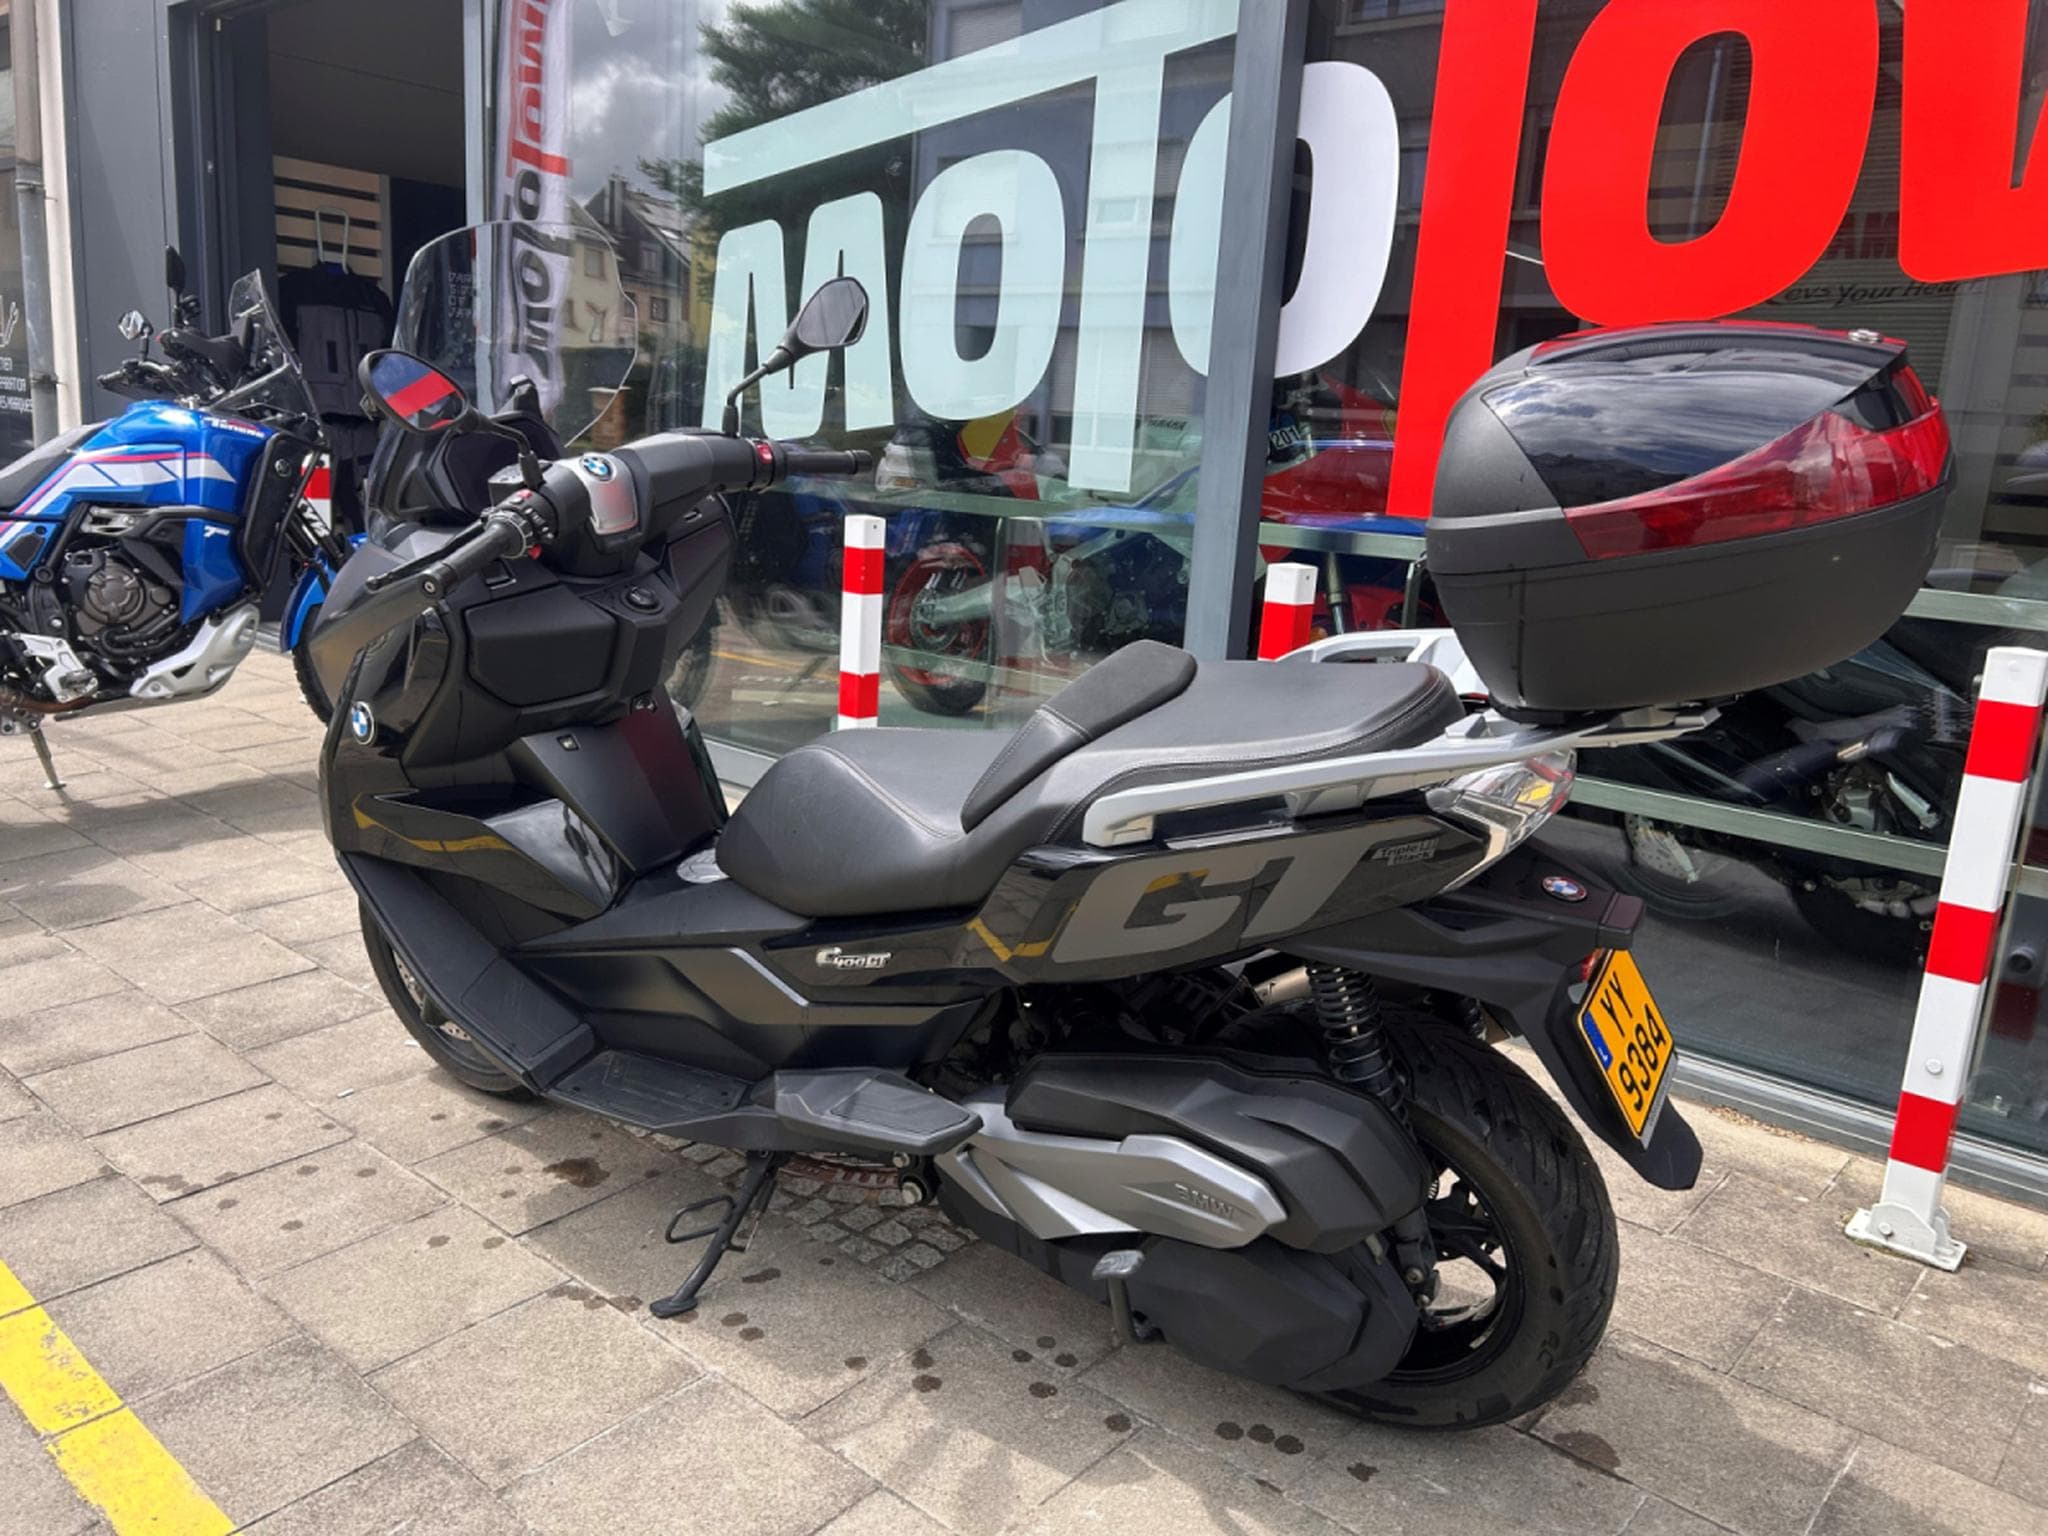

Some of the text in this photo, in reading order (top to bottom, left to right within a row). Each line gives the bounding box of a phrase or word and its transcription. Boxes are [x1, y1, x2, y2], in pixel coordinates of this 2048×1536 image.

[1600, 971, 1633, 1038] YY
[1618, 1003, 1666, 1112] 9384
[1174, 1183, 1234, 1220] BMW
